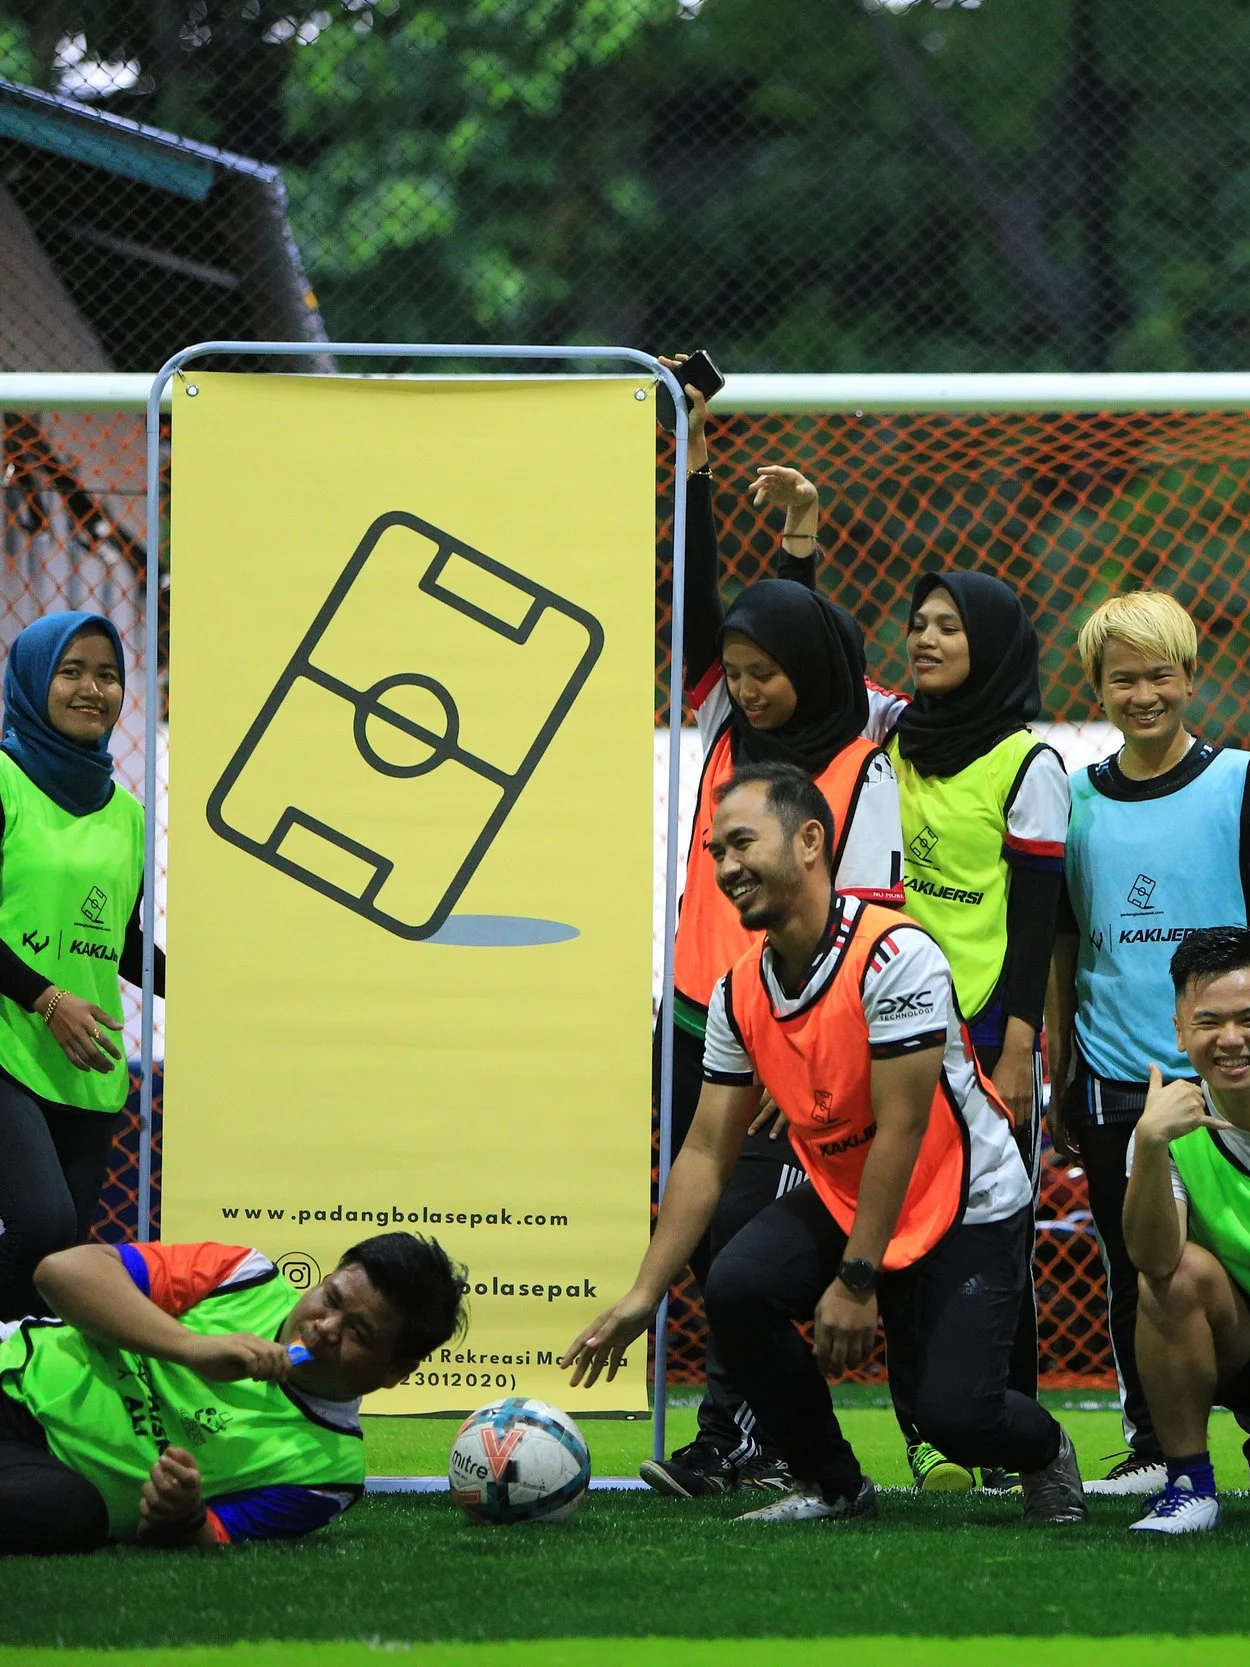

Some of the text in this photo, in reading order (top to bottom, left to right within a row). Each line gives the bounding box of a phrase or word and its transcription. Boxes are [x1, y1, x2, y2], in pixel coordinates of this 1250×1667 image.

[877, 990, 934, 1015] DXC
[880, 1007, 934, 1021] TECHNOLOGY
[221, 1204, 568, 1229] www.padangbolasepak.com
[440, 1348, 531, 1366] Rekreasi
[452, 1450, 489, 1480] mitre
